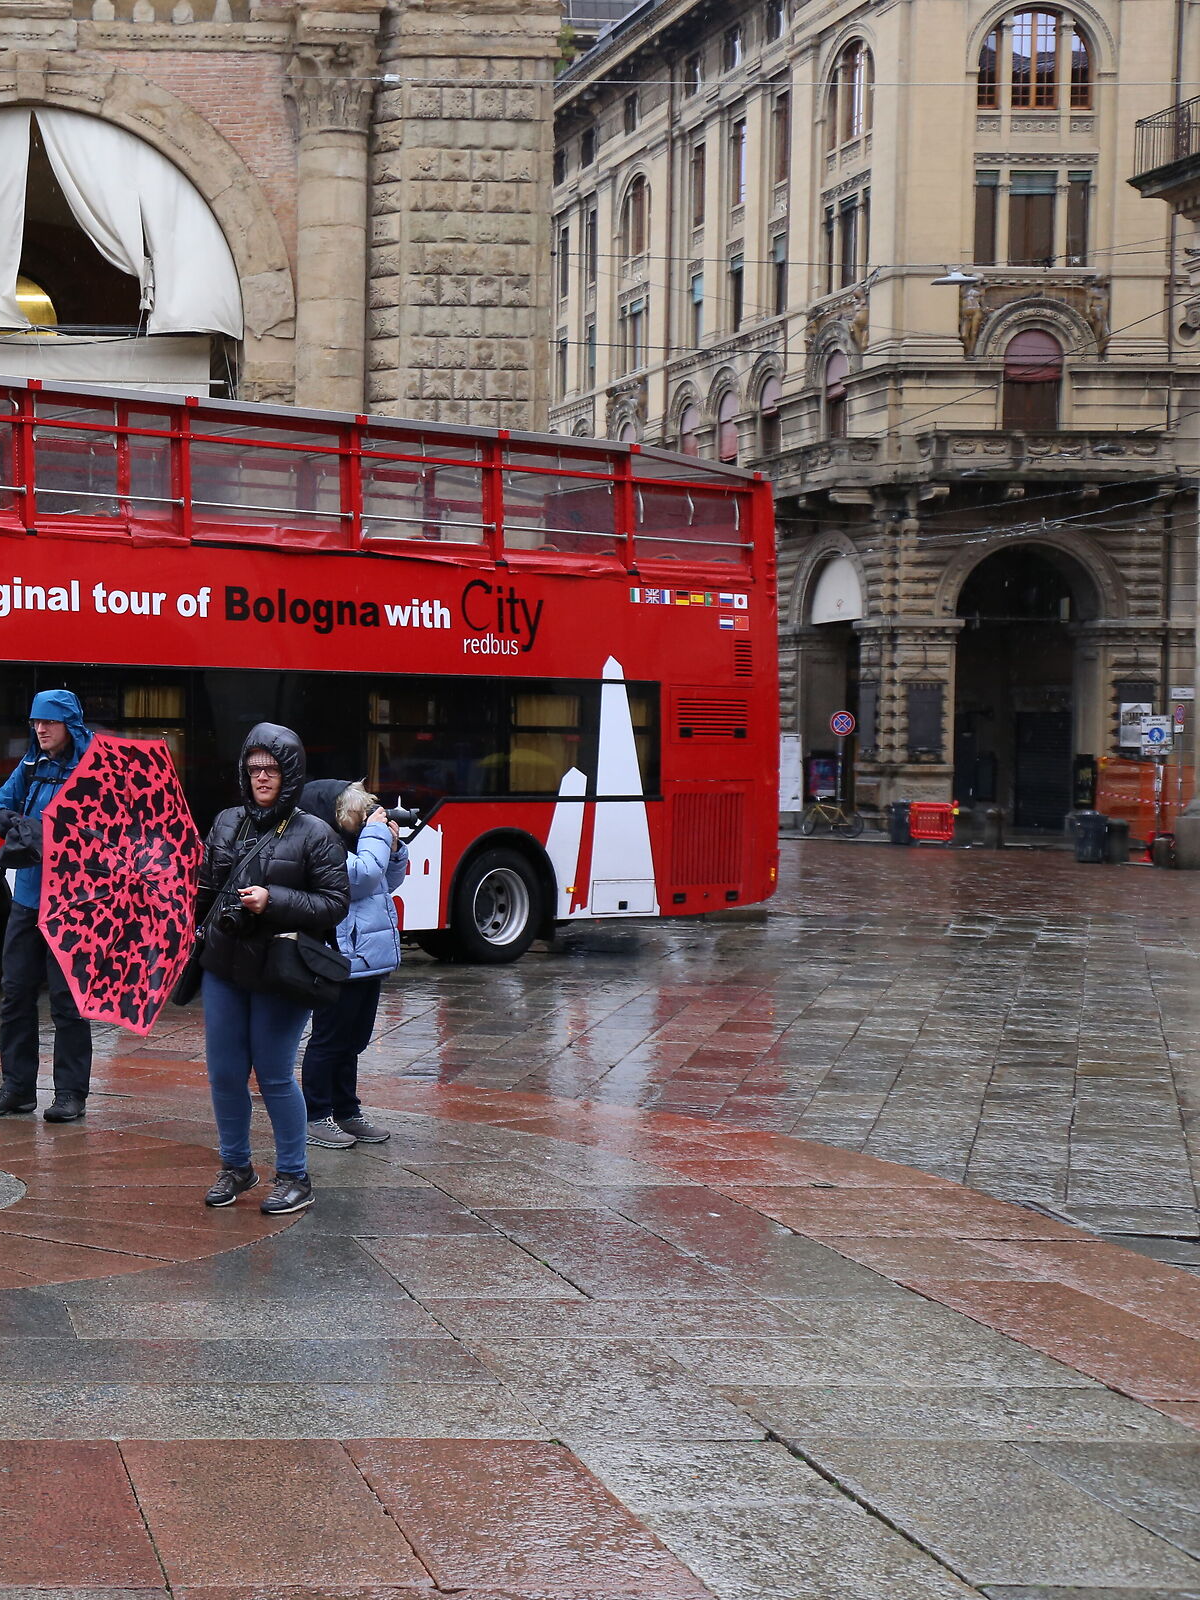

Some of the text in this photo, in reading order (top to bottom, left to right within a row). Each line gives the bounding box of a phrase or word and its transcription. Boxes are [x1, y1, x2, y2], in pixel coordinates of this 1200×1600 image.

[92, 582, 167, 617] tour
[176, 586, 212, 618] of
[224, 586, 380, 634] Bologna
[384, 598, 451, 629] with
[461, 579, 544, 653] City
[463, 632, 519, 656] redbus
